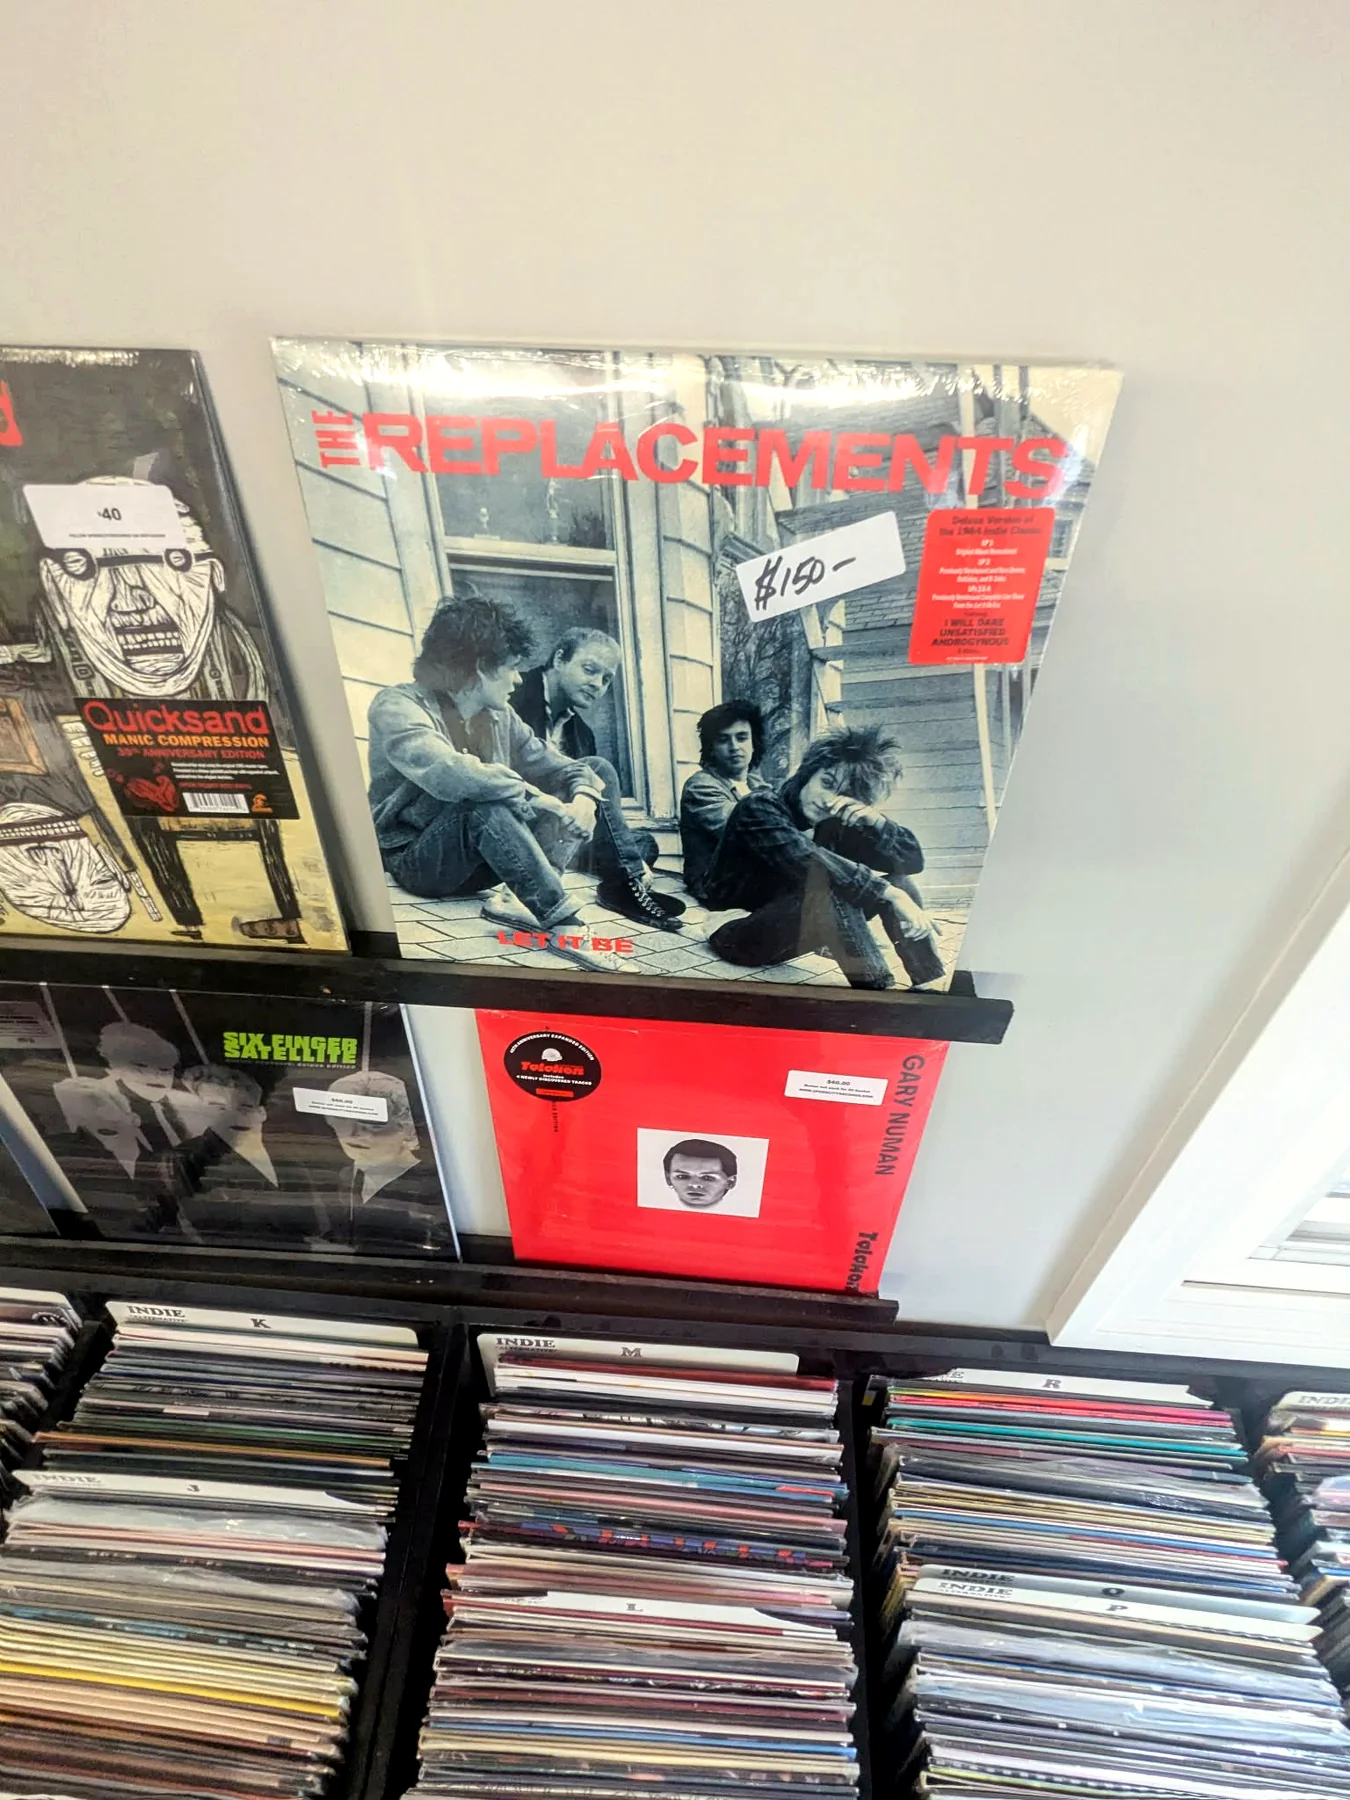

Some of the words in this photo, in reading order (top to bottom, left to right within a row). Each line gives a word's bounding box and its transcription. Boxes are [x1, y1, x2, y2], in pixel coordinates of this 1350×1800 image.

[311, 410, 361, 468] THE
[362, 412, 1067, 498] REPLACEMENTS
[940, 628, 1006, 636] UNSATISFIED
[84, 701, 270, 734] Quicksand
[103, 734, 154, 746] MANIC
[158, 735, 270, 748] COMPRESSION
[143, 749, 218, 758] ANNIVERSARY
[222, 750, 265, 759] EDITION
[497, 930, 549, 948] LET
[557, 935, 584, 950] IT
[591, 937, 633, 953] BE
[223, 1032, 264, 1047] SIX
[272, 1034, 358, 1052] FINGER
[223, 1045, 357, 1064] SATELLITE
[893, 1054, 926, 1107] GARY
[875, 1112, 911, 1175] NUMAN
[126, 1305, 186, 1318] INDIE
[250, 1318, 272, 1329] K
[496, 1337, 556, 1348] INDIE
[620, 1346, 643, 1358] M
[1042, 1378, 1062, 1389] R
[1299, 1395, 1350, 1405] INDI
[942, 1568, 1015, 1582] INDIE
[938, 1582, 1013, 1596] INDIE
[626, 1602, 644, 1612] L
[1106, 1604, 1129, 1612] P
